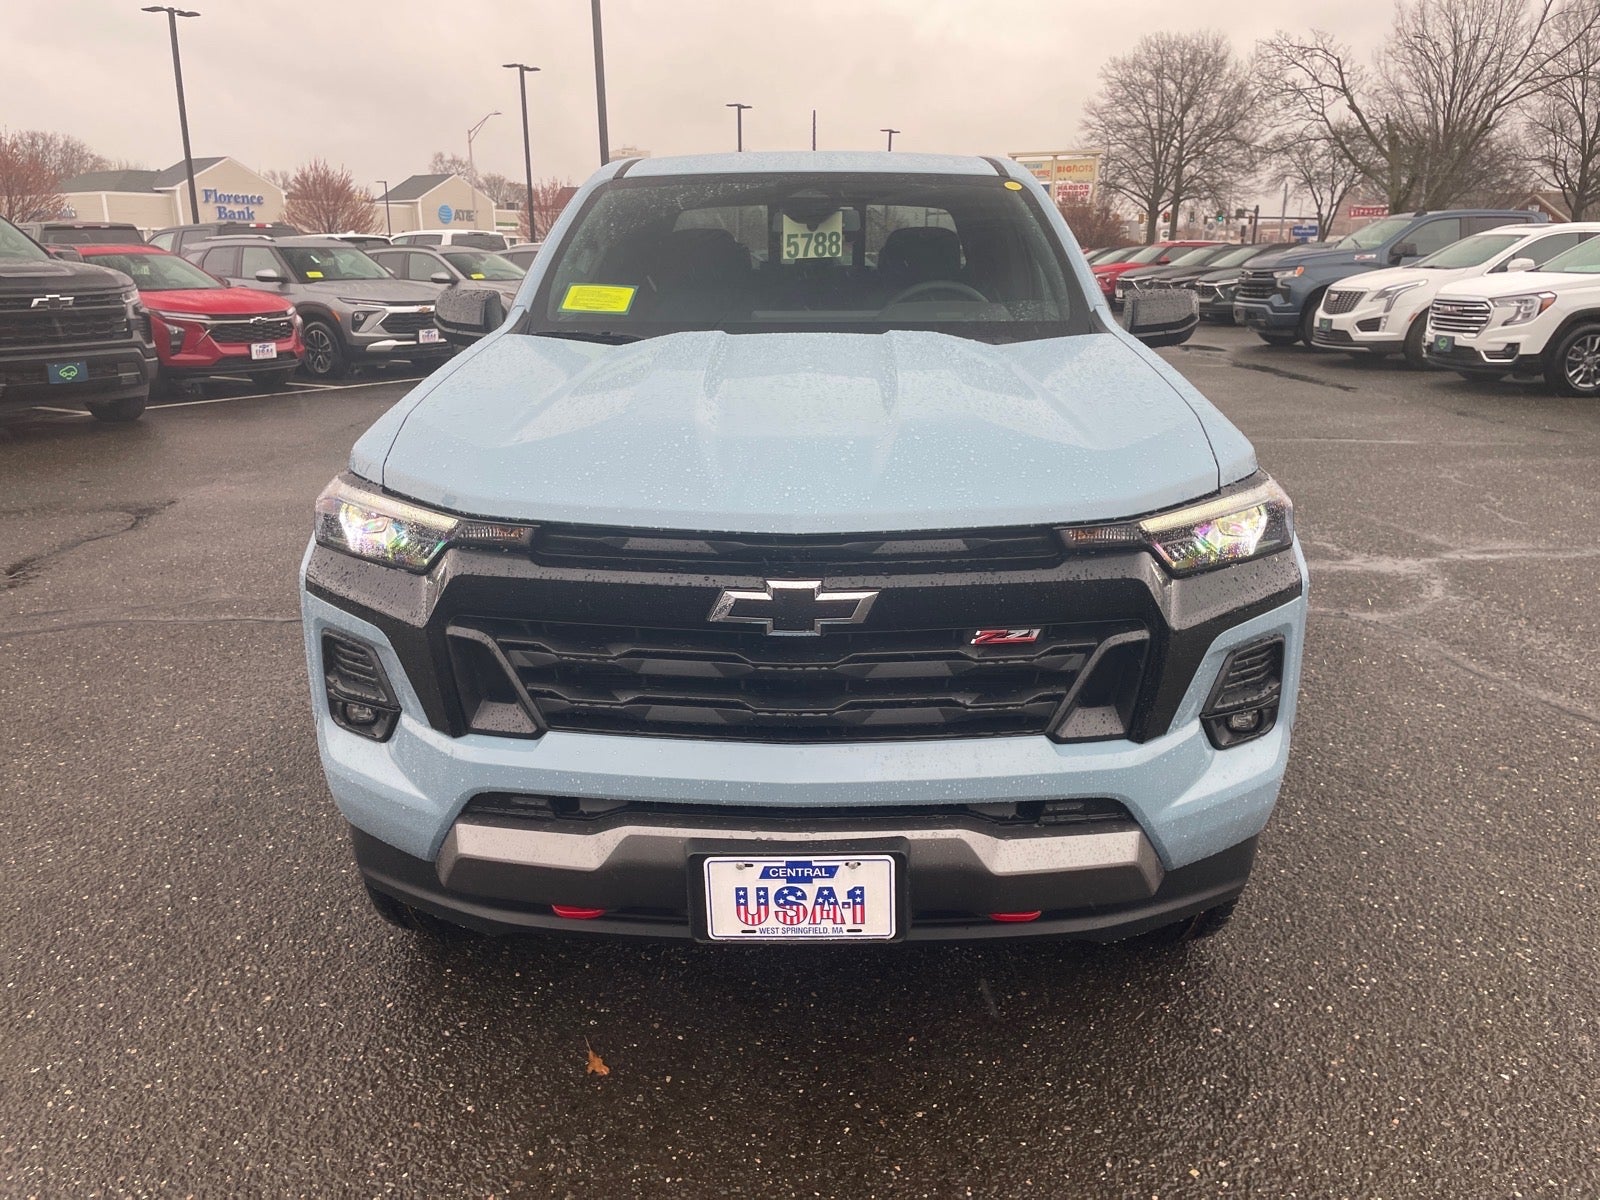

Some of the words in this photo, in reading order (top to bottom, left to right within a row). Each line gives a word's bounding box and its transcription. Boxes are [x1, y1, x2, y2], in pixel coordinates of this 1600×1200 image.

[202, 188, 264, 205] Florence
[216, 206, 255, 221] Bank
[454, 208, 479, 221] AT&
[786, 231, 841, 258] 5788
[769, 866, 830, 878] CENTRAL
[734, 886, 866, 926] USA-1
[759, 927, 780, 935] WEST
[832, 926, 844, 934] MA
